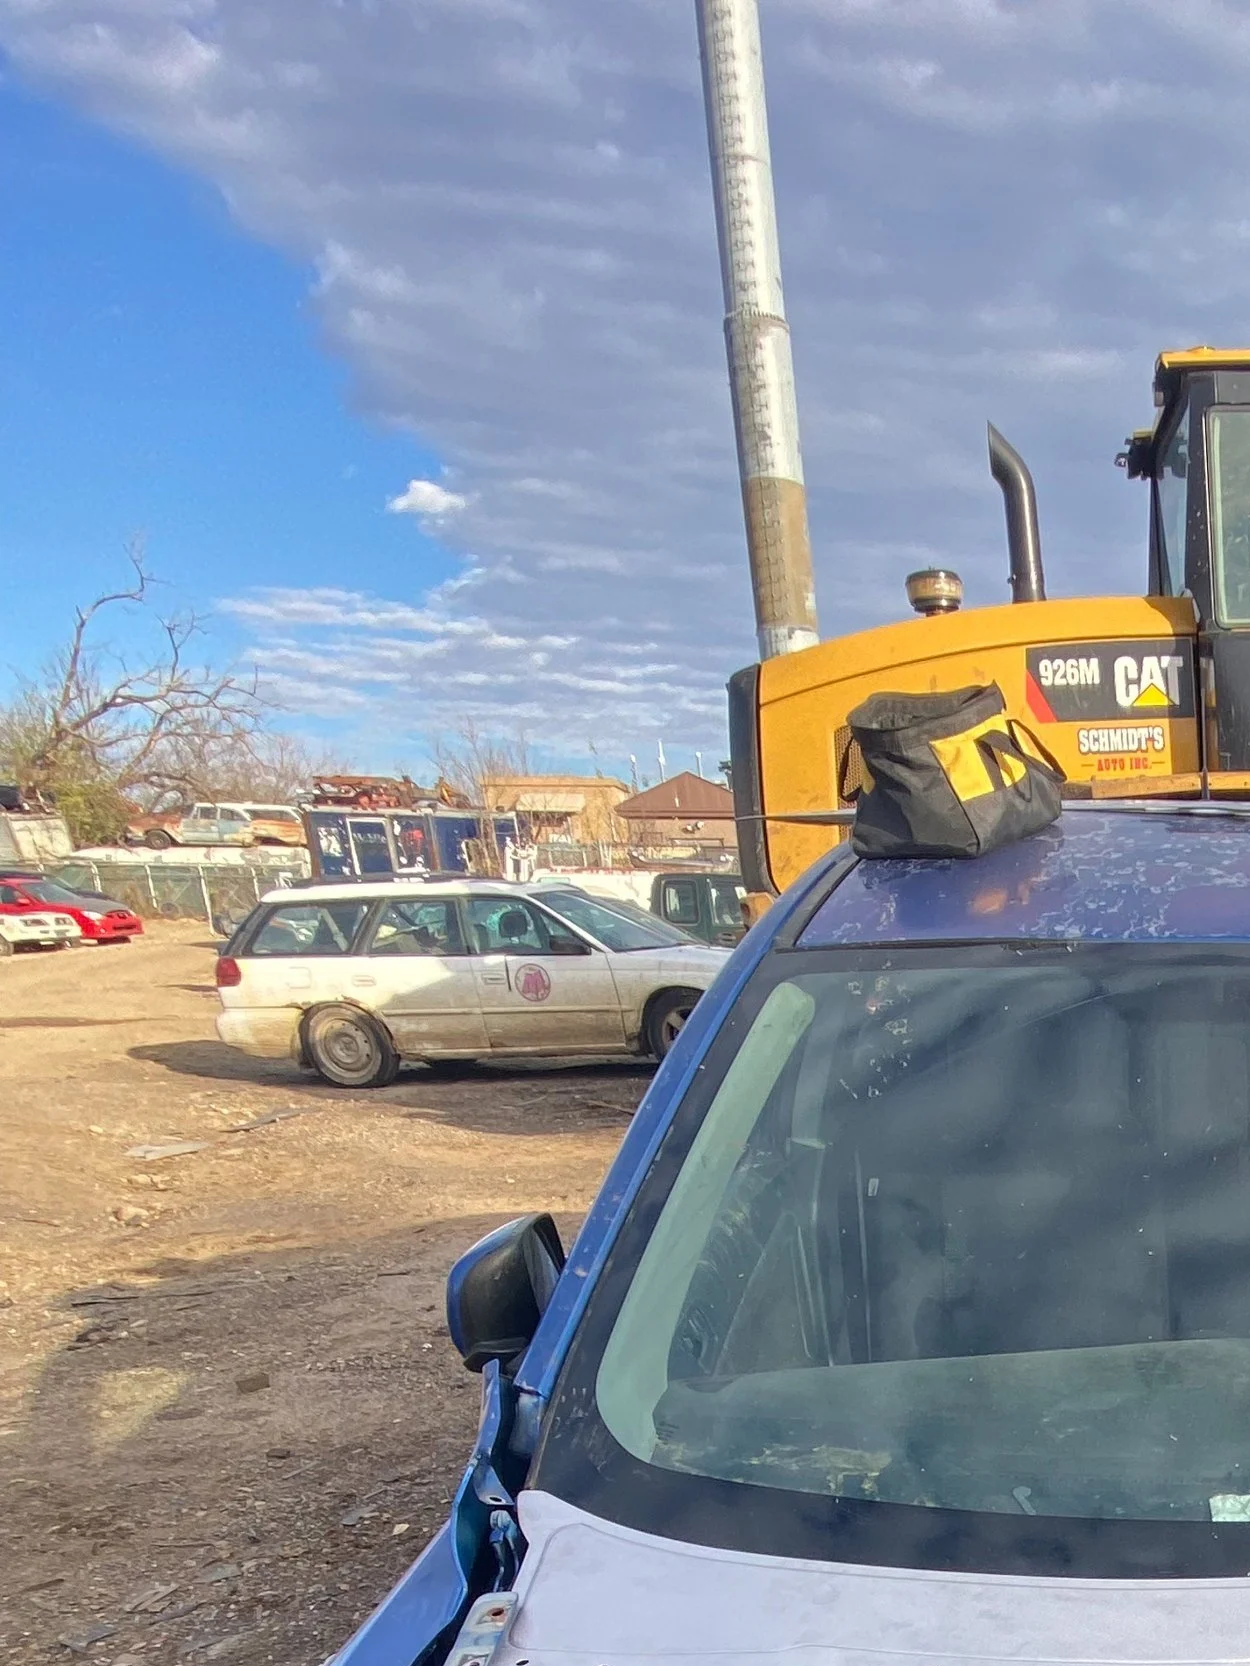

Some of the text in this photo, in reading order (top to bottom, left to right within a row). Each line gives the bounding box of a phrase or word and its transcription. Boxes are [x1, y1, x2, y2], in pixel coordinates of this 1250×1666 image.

[1038, 657, 1100, 687] 926M
[1113, 655, 1184, 707] CAT
[1078, 726, 1165, 754] SCHMIDT'S
[1097, 758, 1125, 772] AUTO
